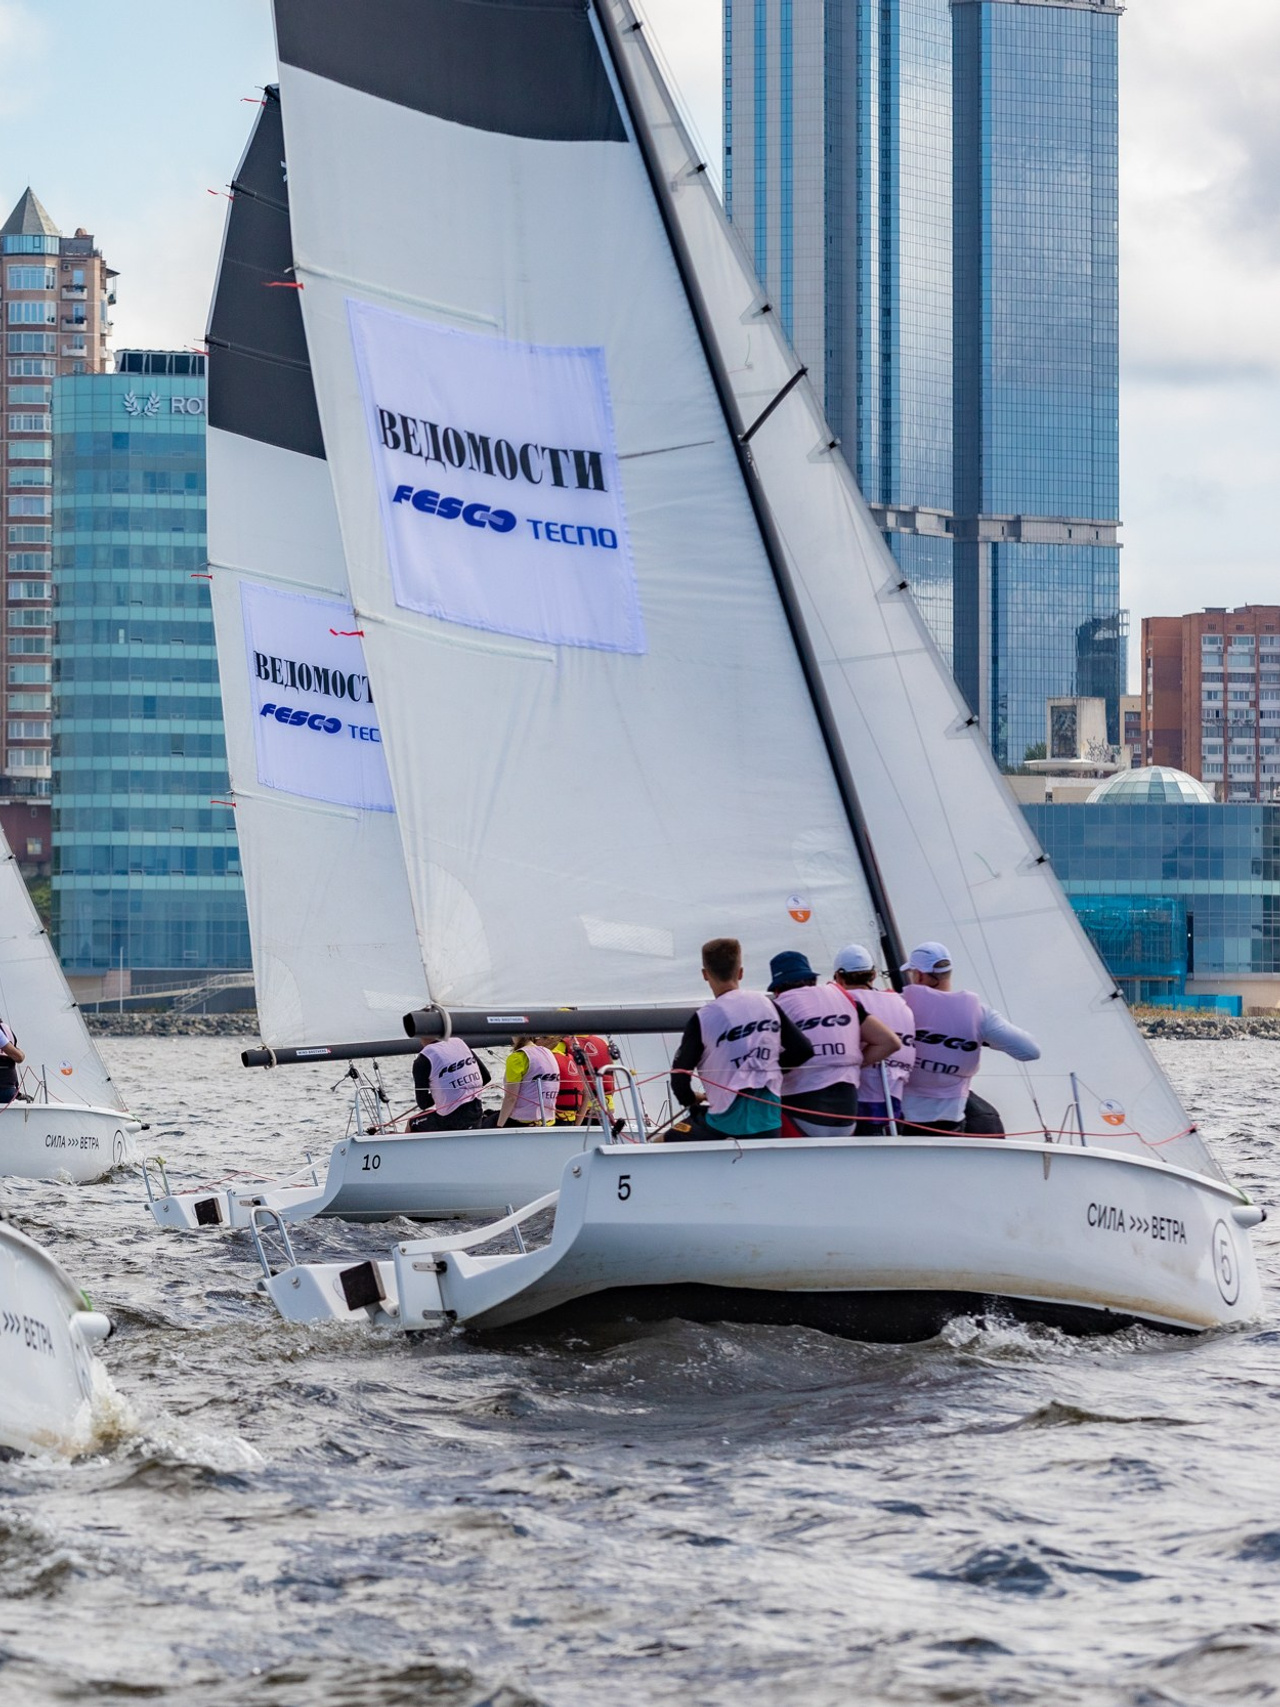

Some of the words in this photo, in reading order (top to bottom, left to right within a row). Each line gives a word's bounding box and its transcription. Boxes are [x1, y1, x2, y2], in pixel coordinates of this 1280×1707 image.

[172, 396, 205, 414] RO
[377, 405, 609, 493] ВЕДОМОСТИ
[392, 484, 517, 533] FESCO
[527, 518, 618, 550] TECNO
[260, 703, 342, 734] FESCO
[348, 724, 381, 742] TEC
[45, 1134, 66, 1149] СИЛА
[80, 1136, 100, 1150] ВЕТРА
[362, 1154, 382, 1171] 10
[618, 1174, 631, 1201] 5
[1087, 1202, 1126, 1233] СИЛА
[1151, 1215, 1187, 1244] ВЕТРА
[23, 1315, 56, 1359] ВЕТРА
